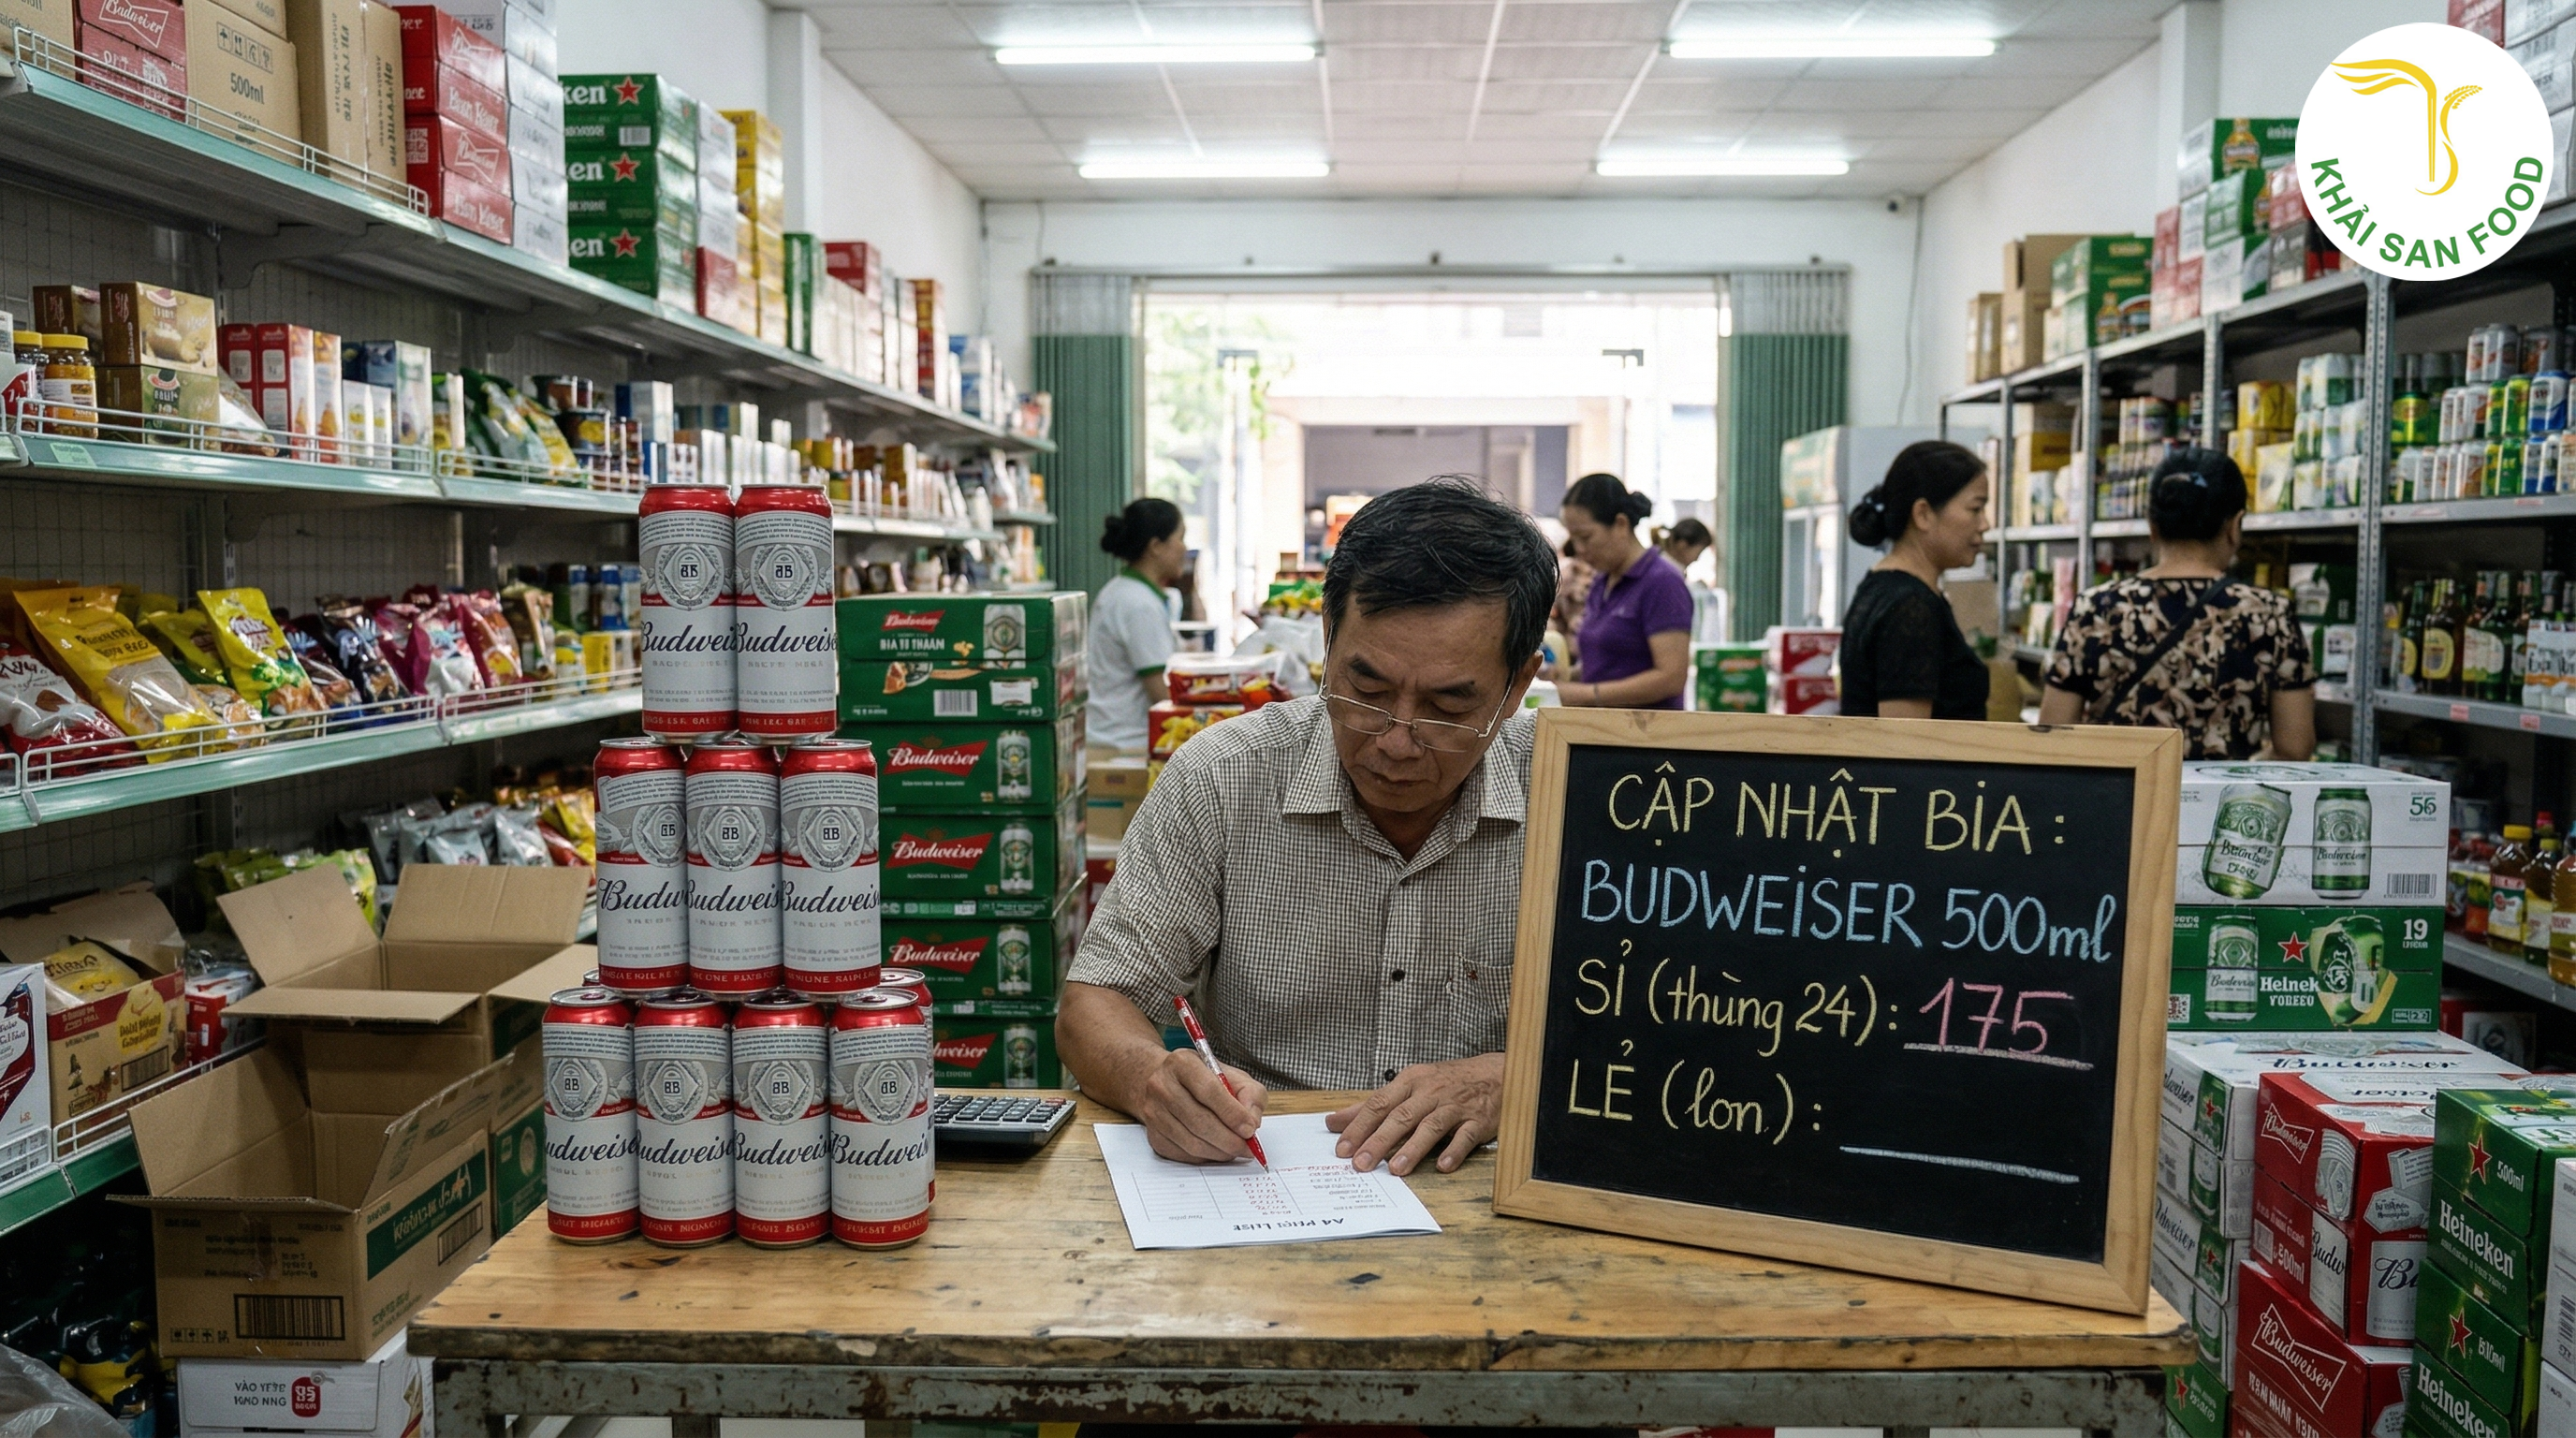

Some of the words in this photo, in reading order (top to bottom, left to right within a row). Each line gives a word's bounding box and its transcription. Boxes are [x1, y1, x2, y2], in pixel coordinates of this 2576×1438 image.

[1608, 760, 1715, 847] CẬP
[1736, 767, 1897, 859] NHẬT
[1941, 888, 2117, 964] 500ml
[2403, 918, 2429, 941] 19
[1575, 938, 1632, 1017] SỈ
[1919, 977, 2074, 1053] 175
[1568, 1038, 1635, 1122] LẺ
[2439, 1199, 2514, 1280] Heineken
[2260, 1313, 2334, 1392] Budweiser
